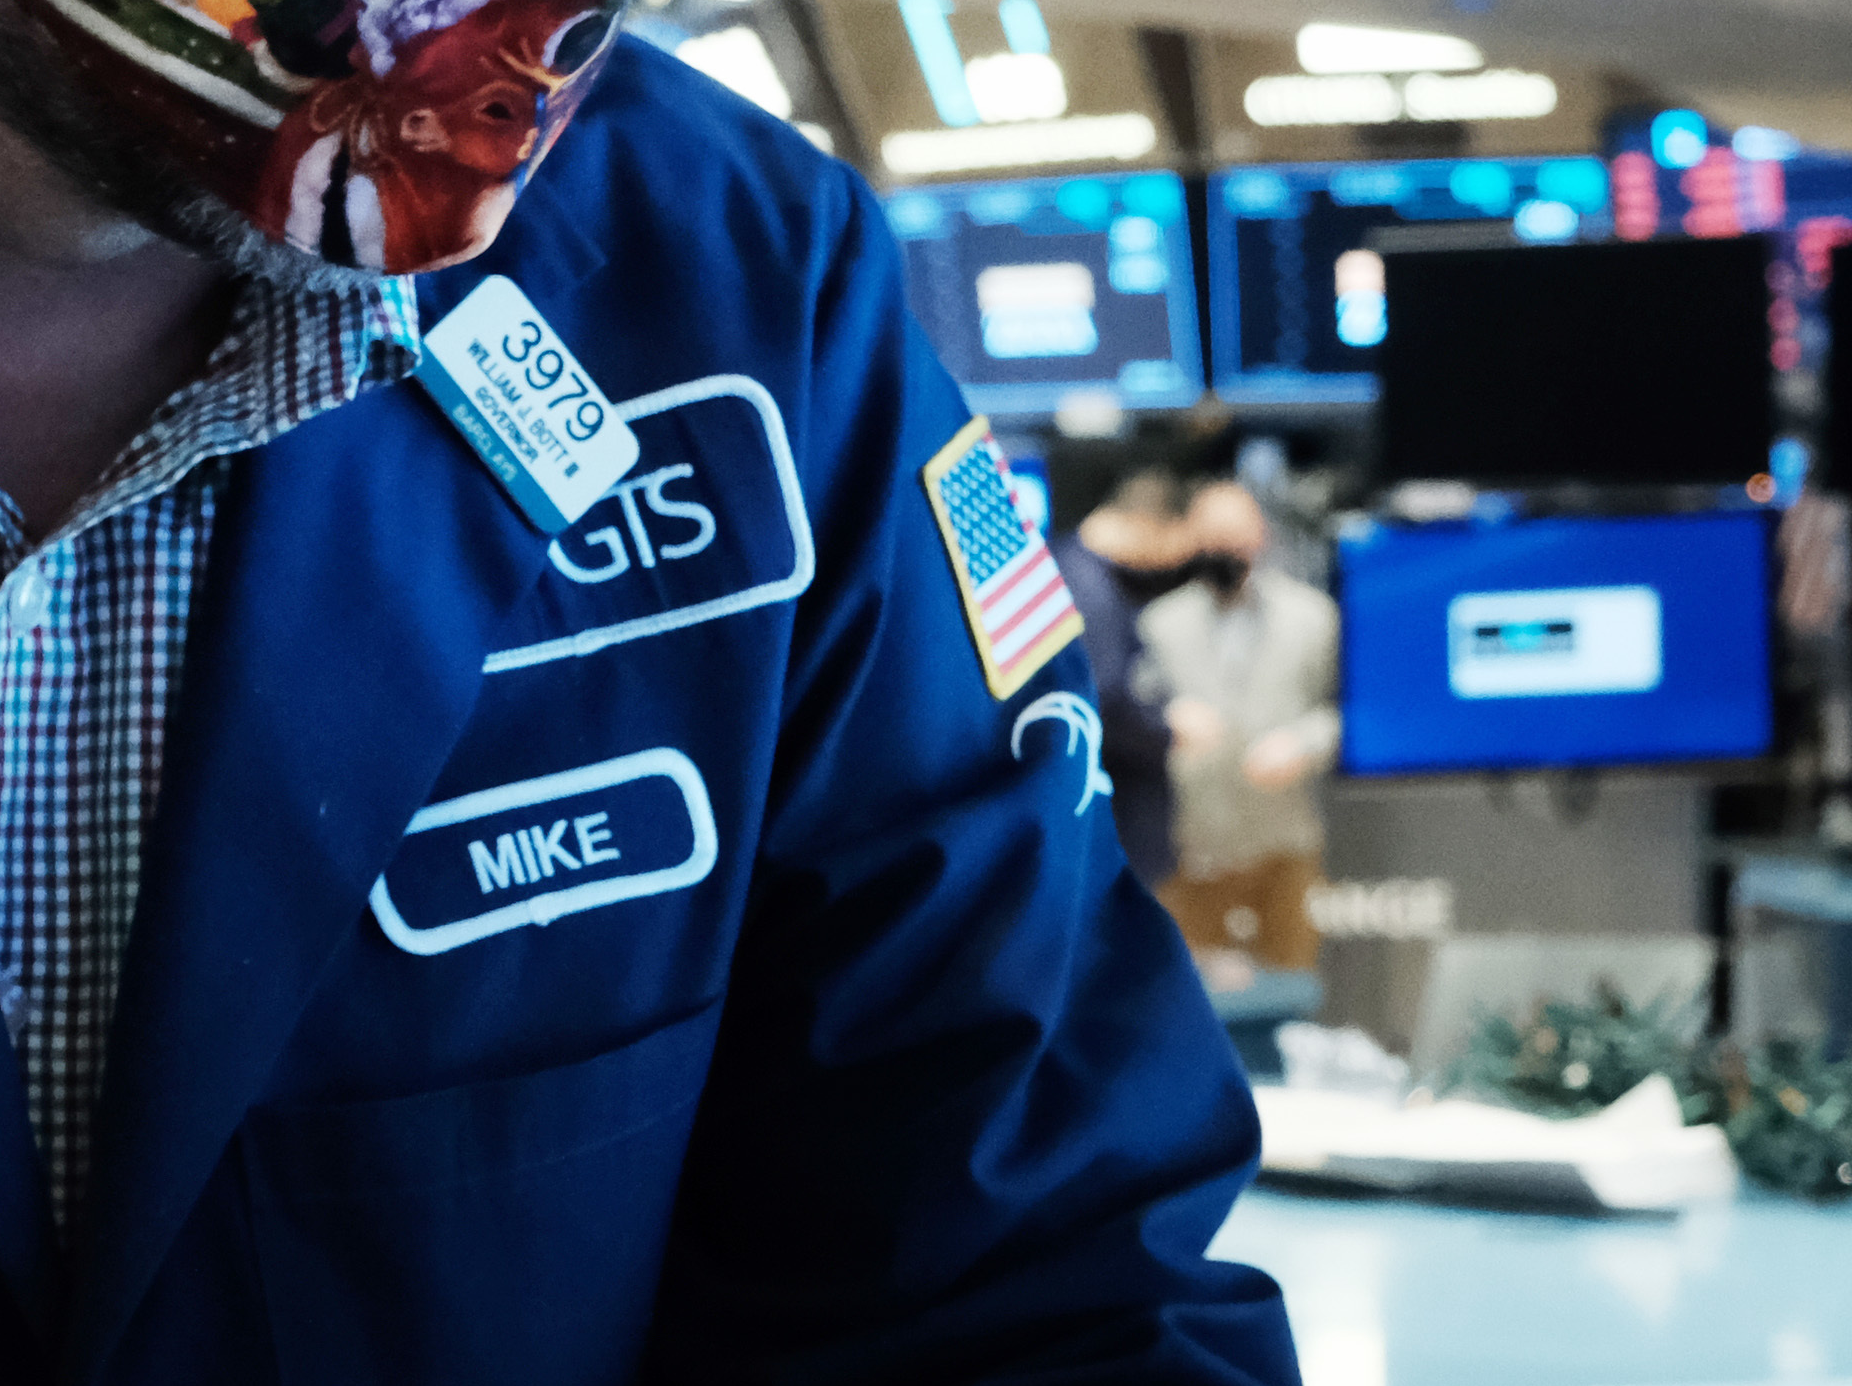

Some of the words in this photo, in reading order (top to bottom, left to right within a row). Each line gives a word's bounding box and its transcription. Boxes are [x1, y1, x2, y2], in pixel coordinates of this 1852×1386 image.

[503, 321, 604, 442] 3979
[548, 463, 717, 584] GTS
[468, 810, 621, 895] MIKE
